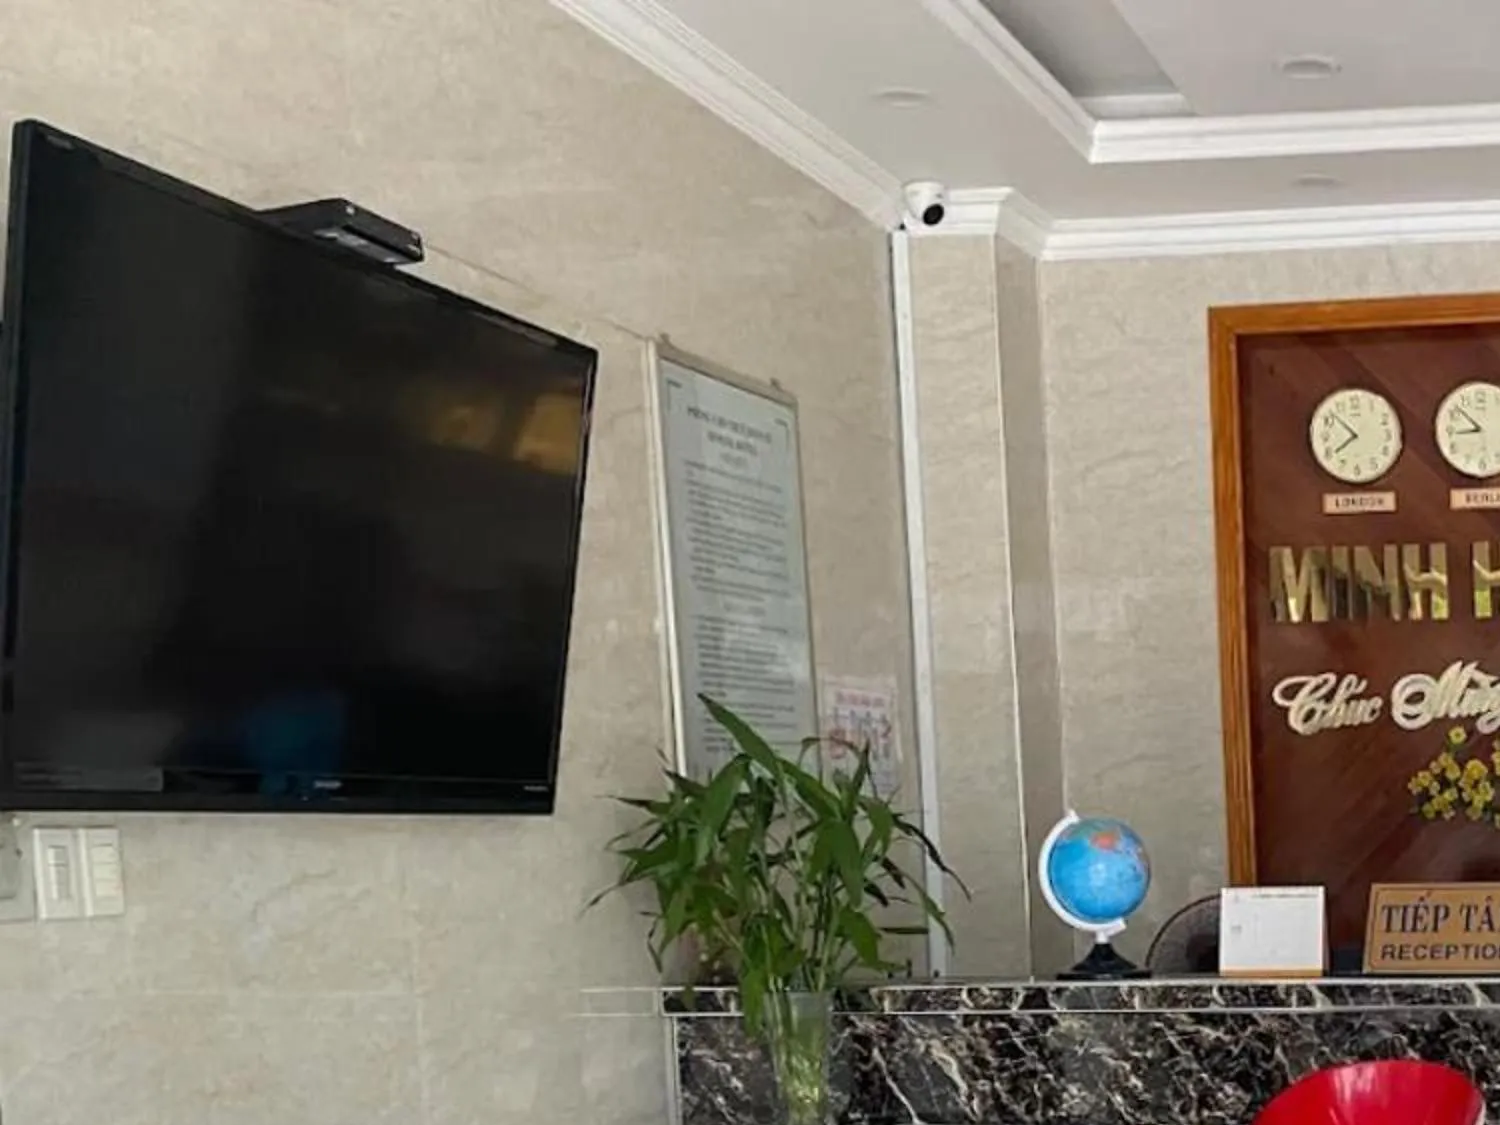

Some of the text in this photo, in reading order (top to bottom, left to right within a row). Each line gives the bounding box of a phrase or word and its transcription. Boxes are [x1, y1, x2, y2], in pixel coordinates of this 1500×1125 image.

[1269, 543, 1449, 623] MINH
[1272, 672, 1383, 735] Chúc
[1381, 889, 1450, 933] TIẾP
